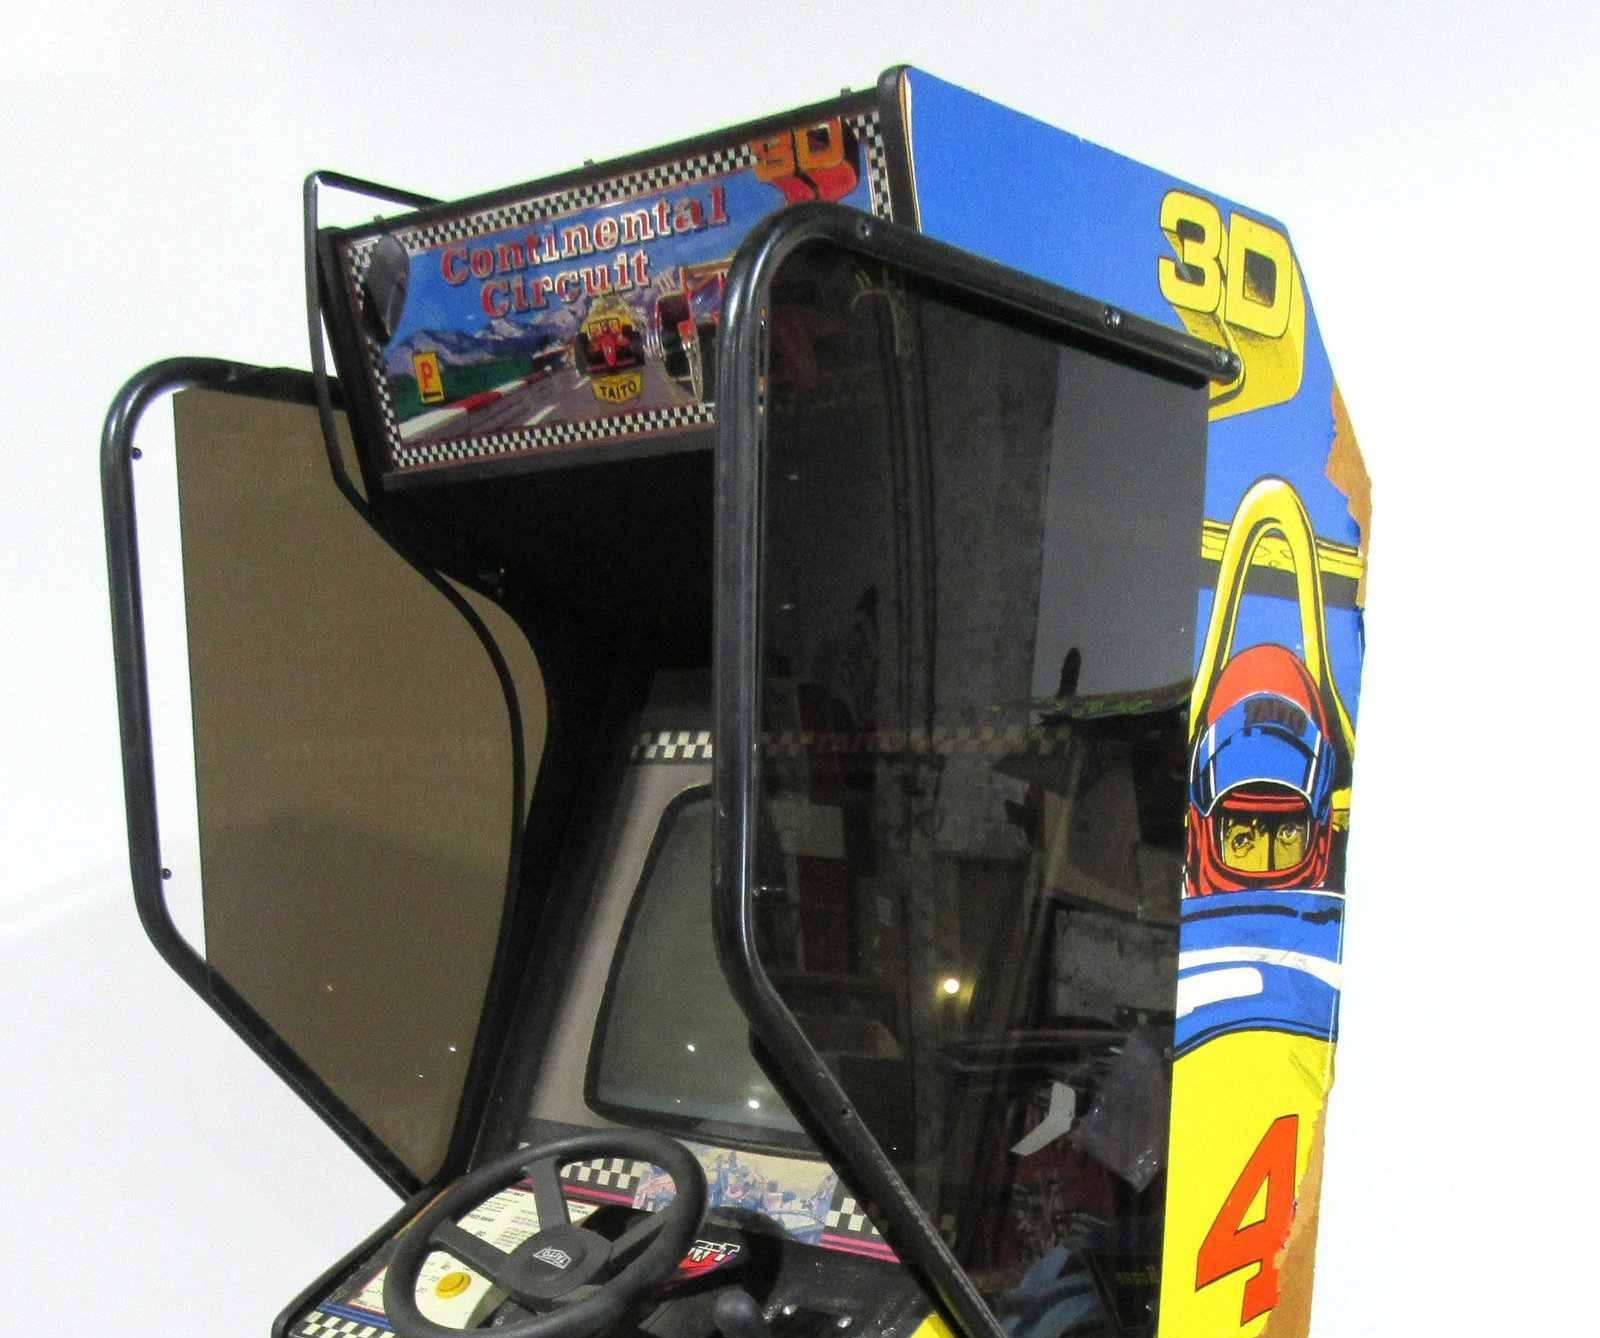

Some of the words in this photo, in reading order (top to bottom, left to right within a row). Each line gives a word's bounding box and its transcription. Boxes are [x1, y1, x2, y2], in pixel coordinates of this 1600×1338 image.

[440, 184, 730, 284] Continental
[1157, 188, 1293, 340] 3D
[480, 249, 652, 319] Circuit
[600, 380, 637, 400] TAITO
[543, 1249, 567, 1264] TAITO
[1195, 1113, 1299, 1327] 4
